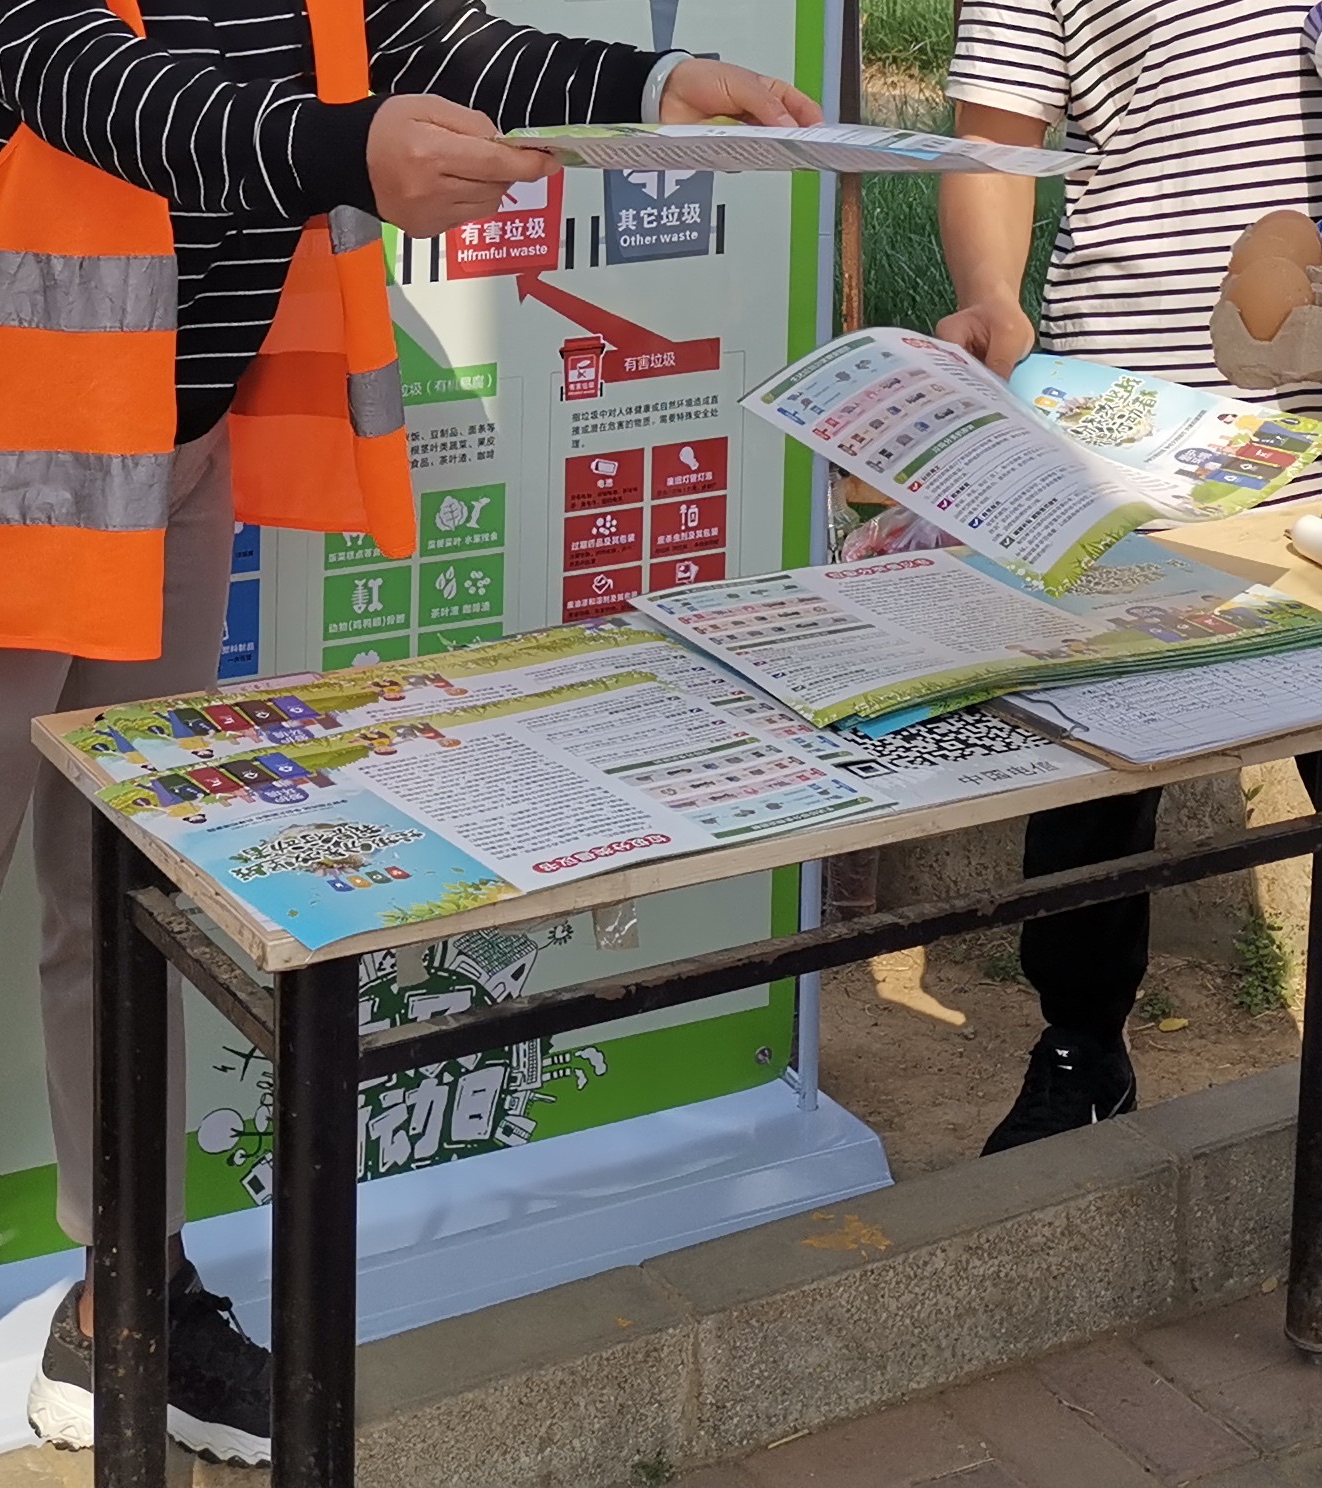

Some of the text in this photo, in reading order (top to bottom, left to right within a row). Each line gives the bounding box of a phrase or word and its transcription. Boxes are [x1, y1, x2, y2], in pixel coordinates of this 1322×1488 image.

[617, 204, 701, 231] 其它垃圾
[460, 217, 546, 245] 有害垃圾
[620, 230, 699, 248] Other waste
[510, 244, 548, 257] waste
[624, 351, 676, 372] 有害垃圾
[958, 761, 1059, 785] 中国电信
